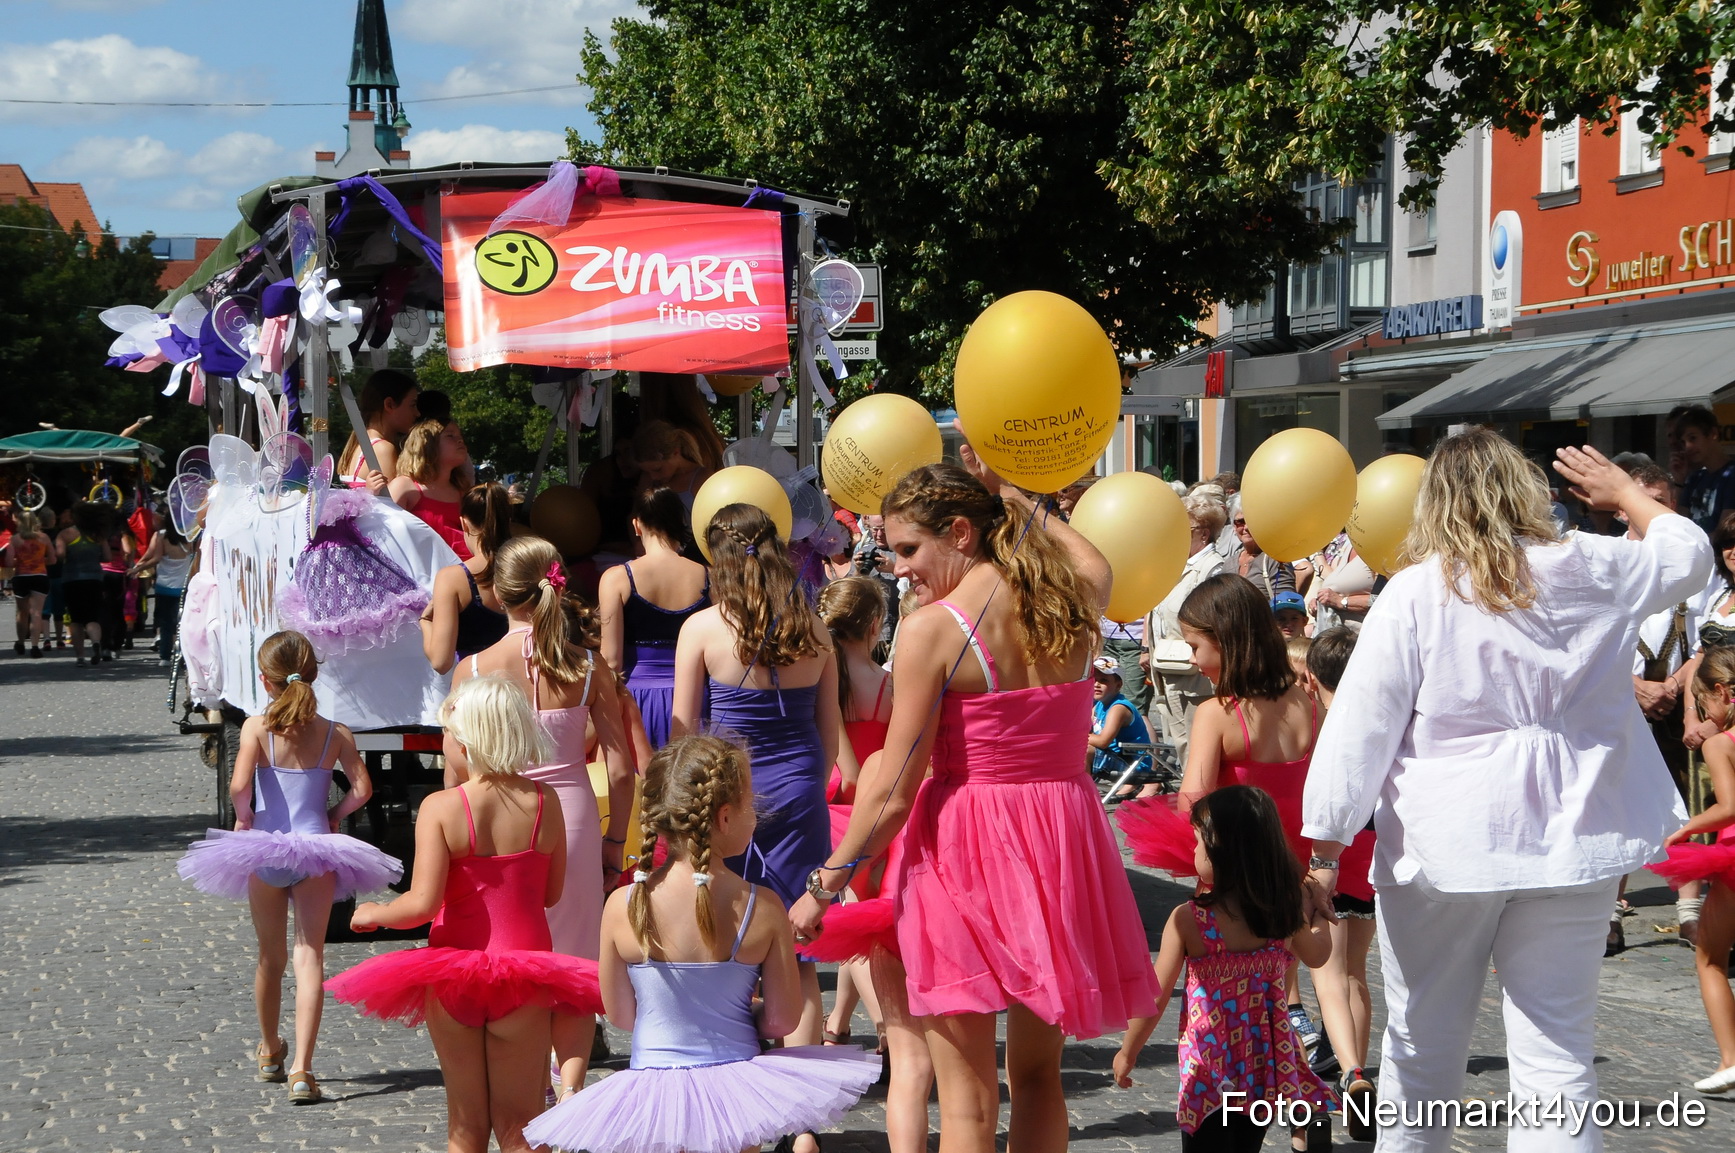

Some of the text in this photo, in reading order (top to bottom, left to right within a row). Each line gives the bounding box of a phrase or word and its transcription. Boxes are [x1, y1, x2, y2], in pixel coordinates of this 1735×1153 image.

[657, 302, 761, 332] fitness
[1382, 295, 1474, 339] TABAKWAREN
[1003, 406, 1085, 433] CENTRUM
[993, 431, 1069, 448] Neumarkt
[1033, 454, 1061, 464] 09181
[1064, 443, 1088, 459] 8555
[834, 438, 866, 478] Neumarkt
[844, 436, 884, 478] CENTRUM
